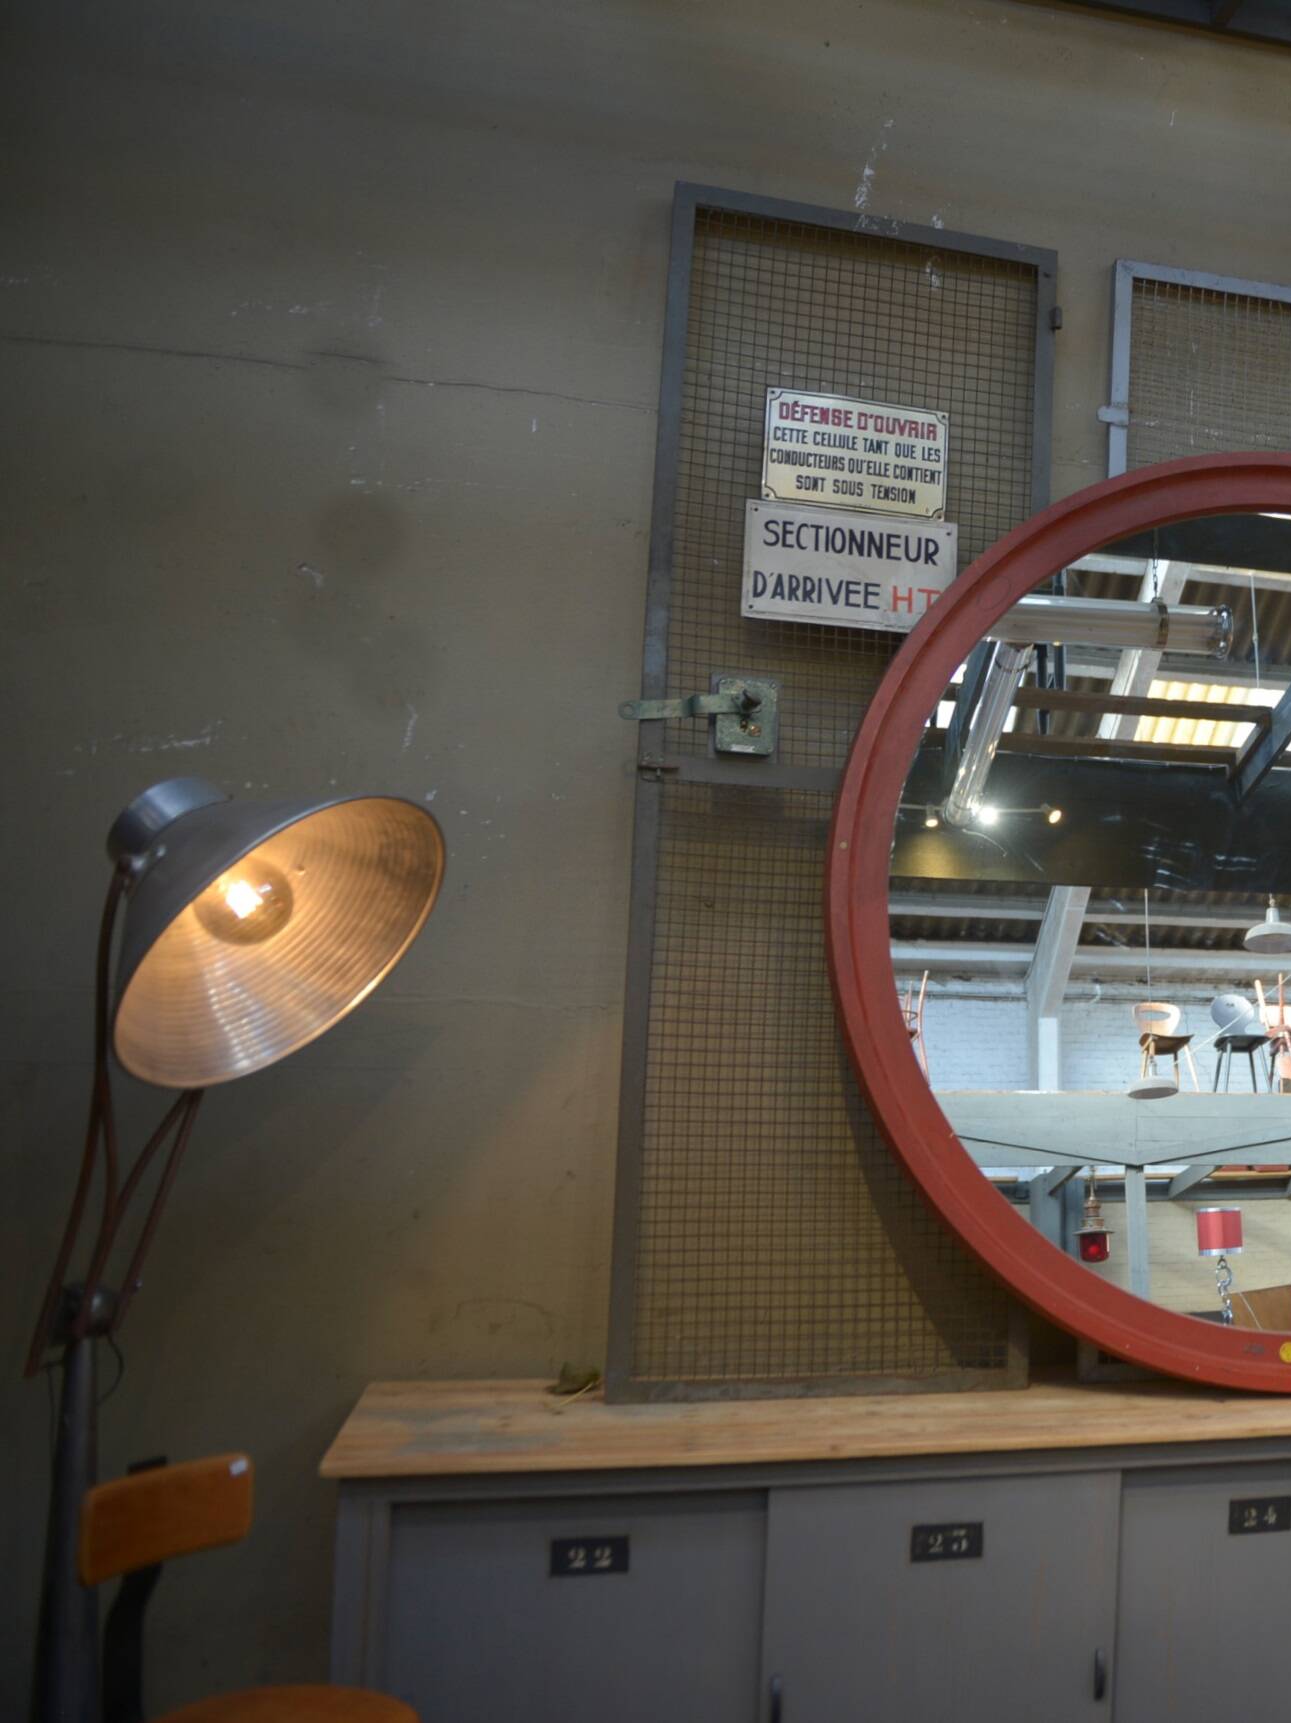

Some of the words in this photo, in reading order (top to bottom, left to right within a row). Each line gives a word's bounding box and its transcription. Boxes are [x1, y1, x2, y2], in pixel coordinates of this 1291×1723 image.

[779, 400, 853, 429] DÉFENSE
[857, 413, 938, 441] D'OUVRIR
[773, 426, 808, 445] CETTE
[813, 431, 858, 451] CELLULE
[863, 437, 890, 456] TANT
[894, 441, 917, 460] QUE
[921, 445, 941, 463] LES
[769, 448, 846, 472] CONDUCTEURS
[848, 457, 890, 479] QU'ELLE
[893, 464, 942, 486] CONTIENT
[796, 475, 826, 493] SONT
[832, 479, 864, 497] SOUS
[871, 483, 916, 504] TENSION
[763, 519, 940, 566] SECTIONNEUR
[752, 570, 881, 610] D'ARRIVEE
[891, 585, 942, 614] HT
[1243, 1504, 1277, 1527] 24
[567, 1546, 612, 1568] 22
[927, 1528, 968, 1553] 23
